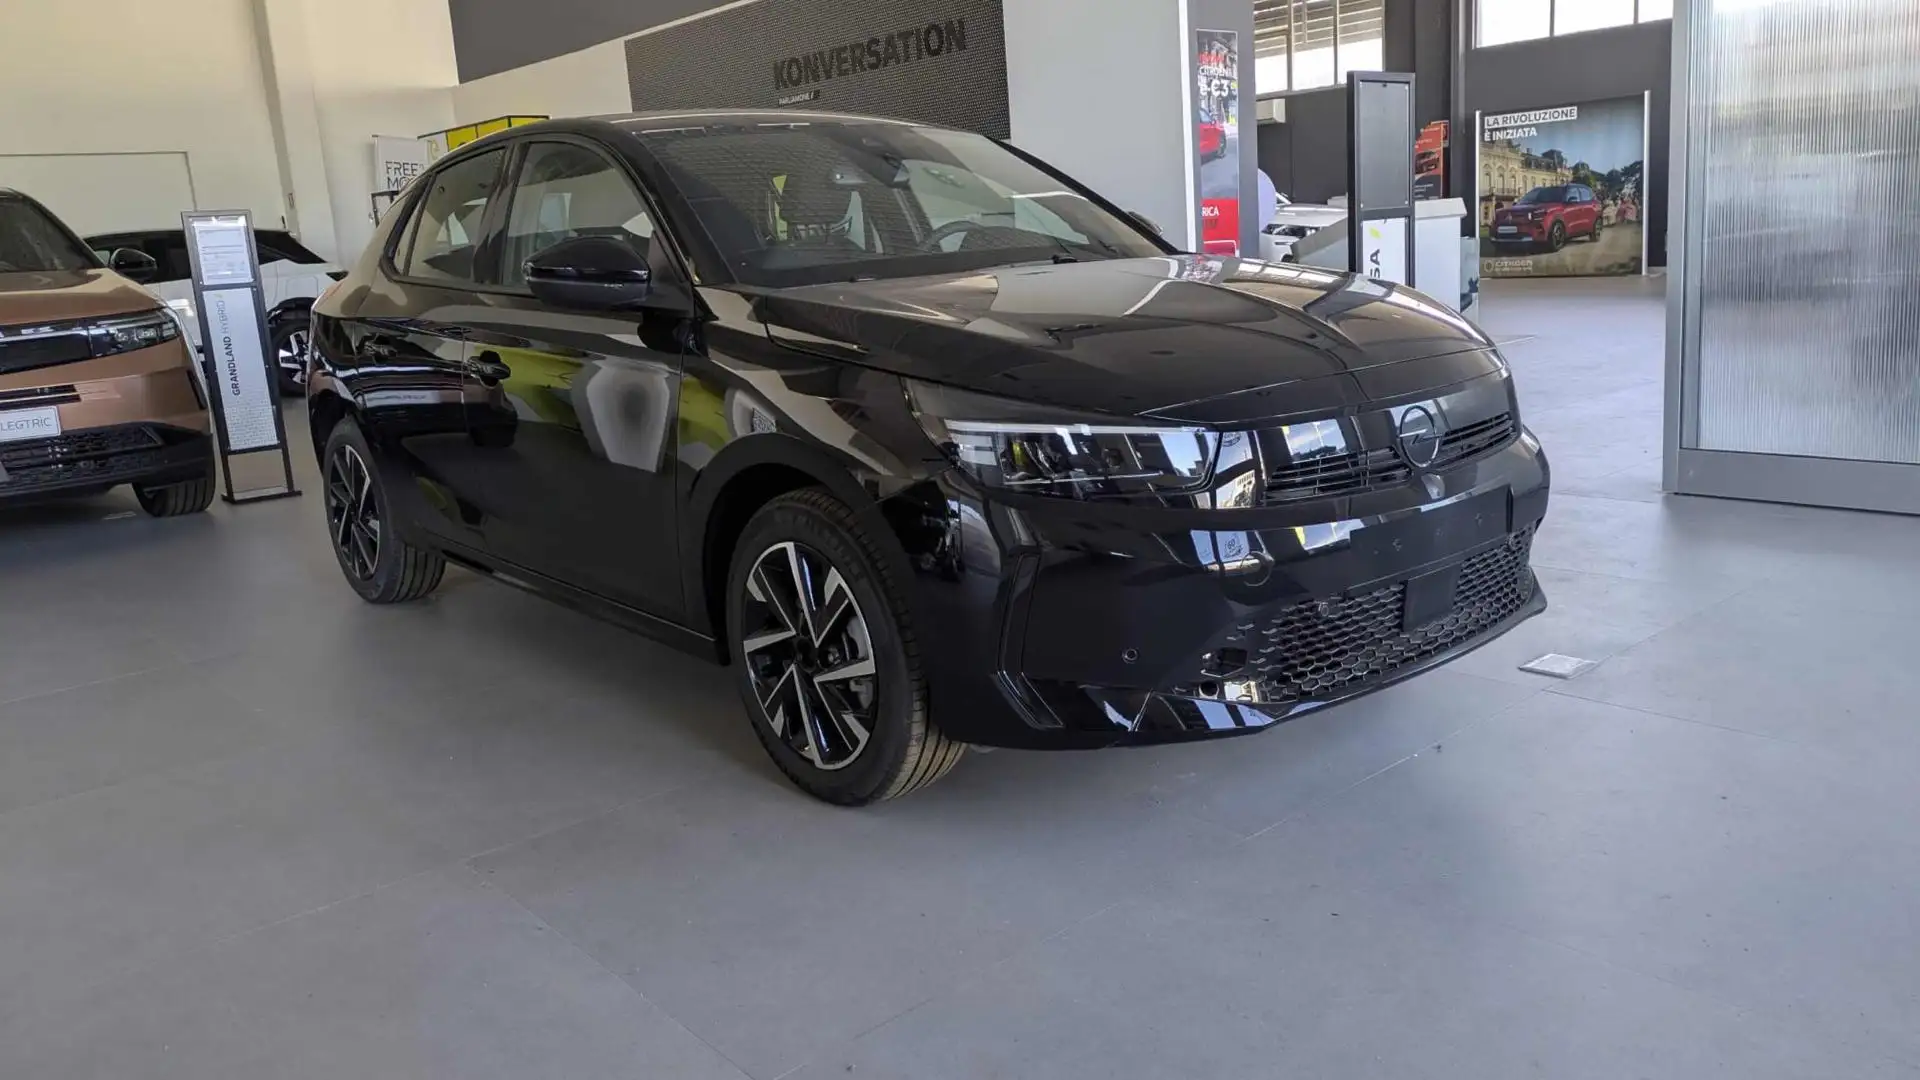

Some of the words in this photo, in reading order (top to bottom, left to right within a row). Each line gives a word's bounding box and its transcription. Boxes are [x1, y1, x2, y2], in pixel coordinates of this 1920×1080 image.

[774, 20, 966, 90] KONVERSATION
[1486, 117, 1500, 128] LA
[1502, 108, 1575, 125] RIVOLUZIONE
[1492, 127, 1538, 141] INIZIATA
[215, 299, 229, 335] HYBRID
[223, 335, 241, 397] GRANDLAND
